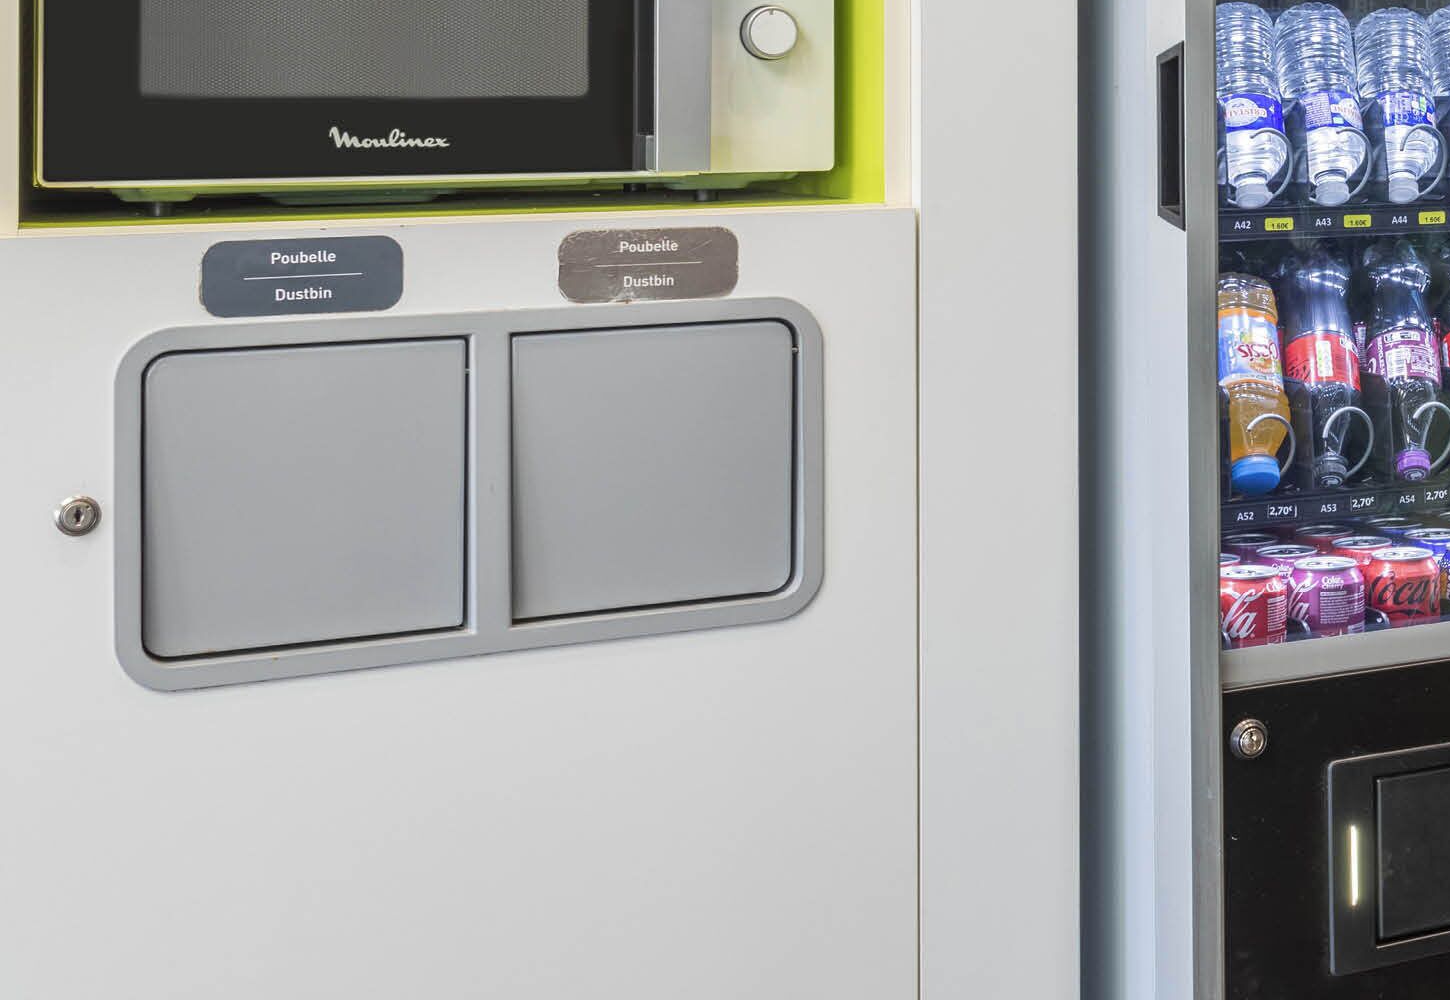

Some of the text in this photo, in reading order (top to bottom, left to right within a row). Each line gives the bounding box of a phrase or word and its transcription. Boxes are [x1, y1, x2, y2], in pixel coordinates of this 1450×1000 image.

[328, 126, 451, 149] Moulinex
[1234, 219, 1252, 230] A42
[1315, 217, 1332, 227] A43
[1392, 215, 1408, 225] A44
[619, 238, 679, 254] Poubelle
[270, 249, 337, 265] Poubelle
[623, 272, 675, 288] Dustbin
[274, 285, 332, 302] Dustbin
[1399, 494, 1415, 504] A54
[1320, 503, 1337, 513] A53
[1237, 511, 1254, 521] A52
